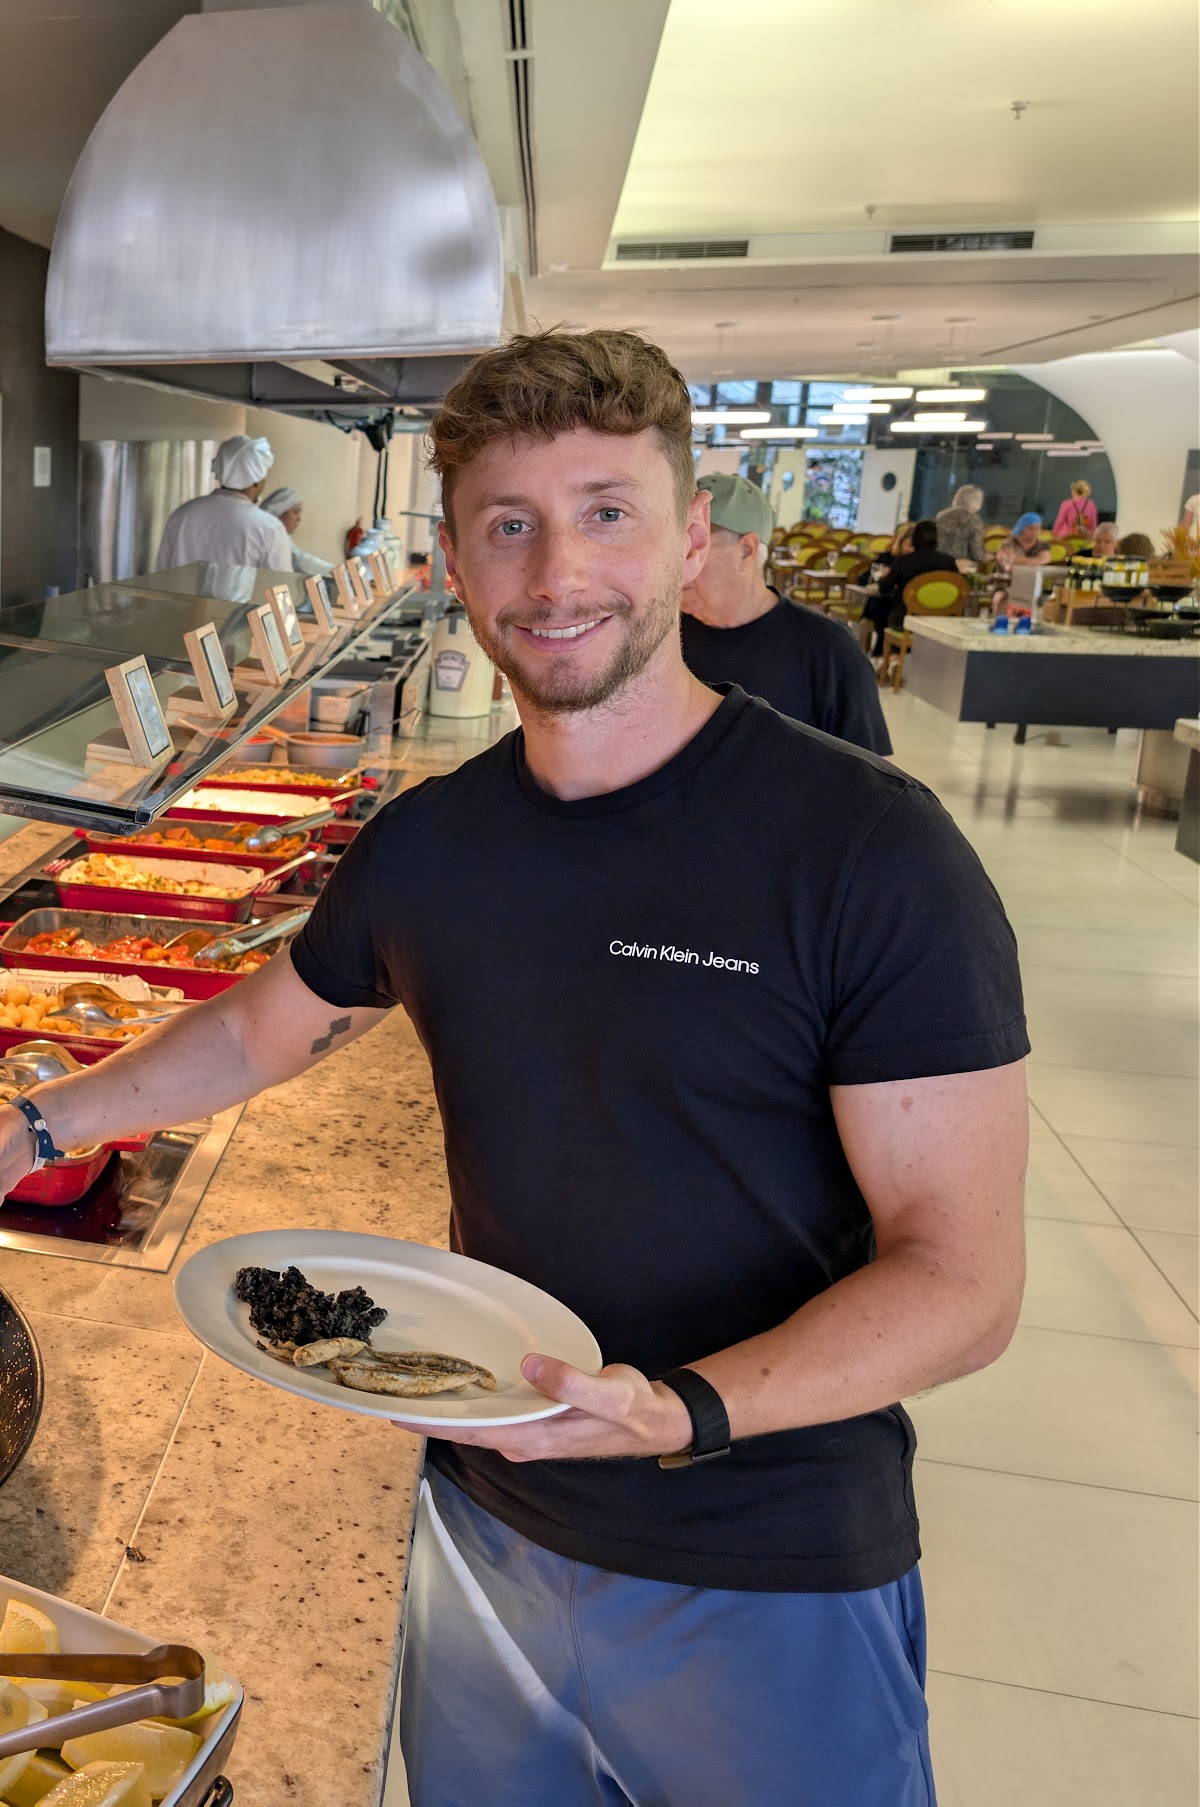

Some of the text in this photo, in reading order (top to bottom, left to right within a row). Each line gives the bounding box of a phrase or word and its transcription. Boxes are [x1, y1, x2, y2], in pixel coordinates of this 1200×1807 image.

[609, 939, 760, 975] Calvin Klein Jeans
